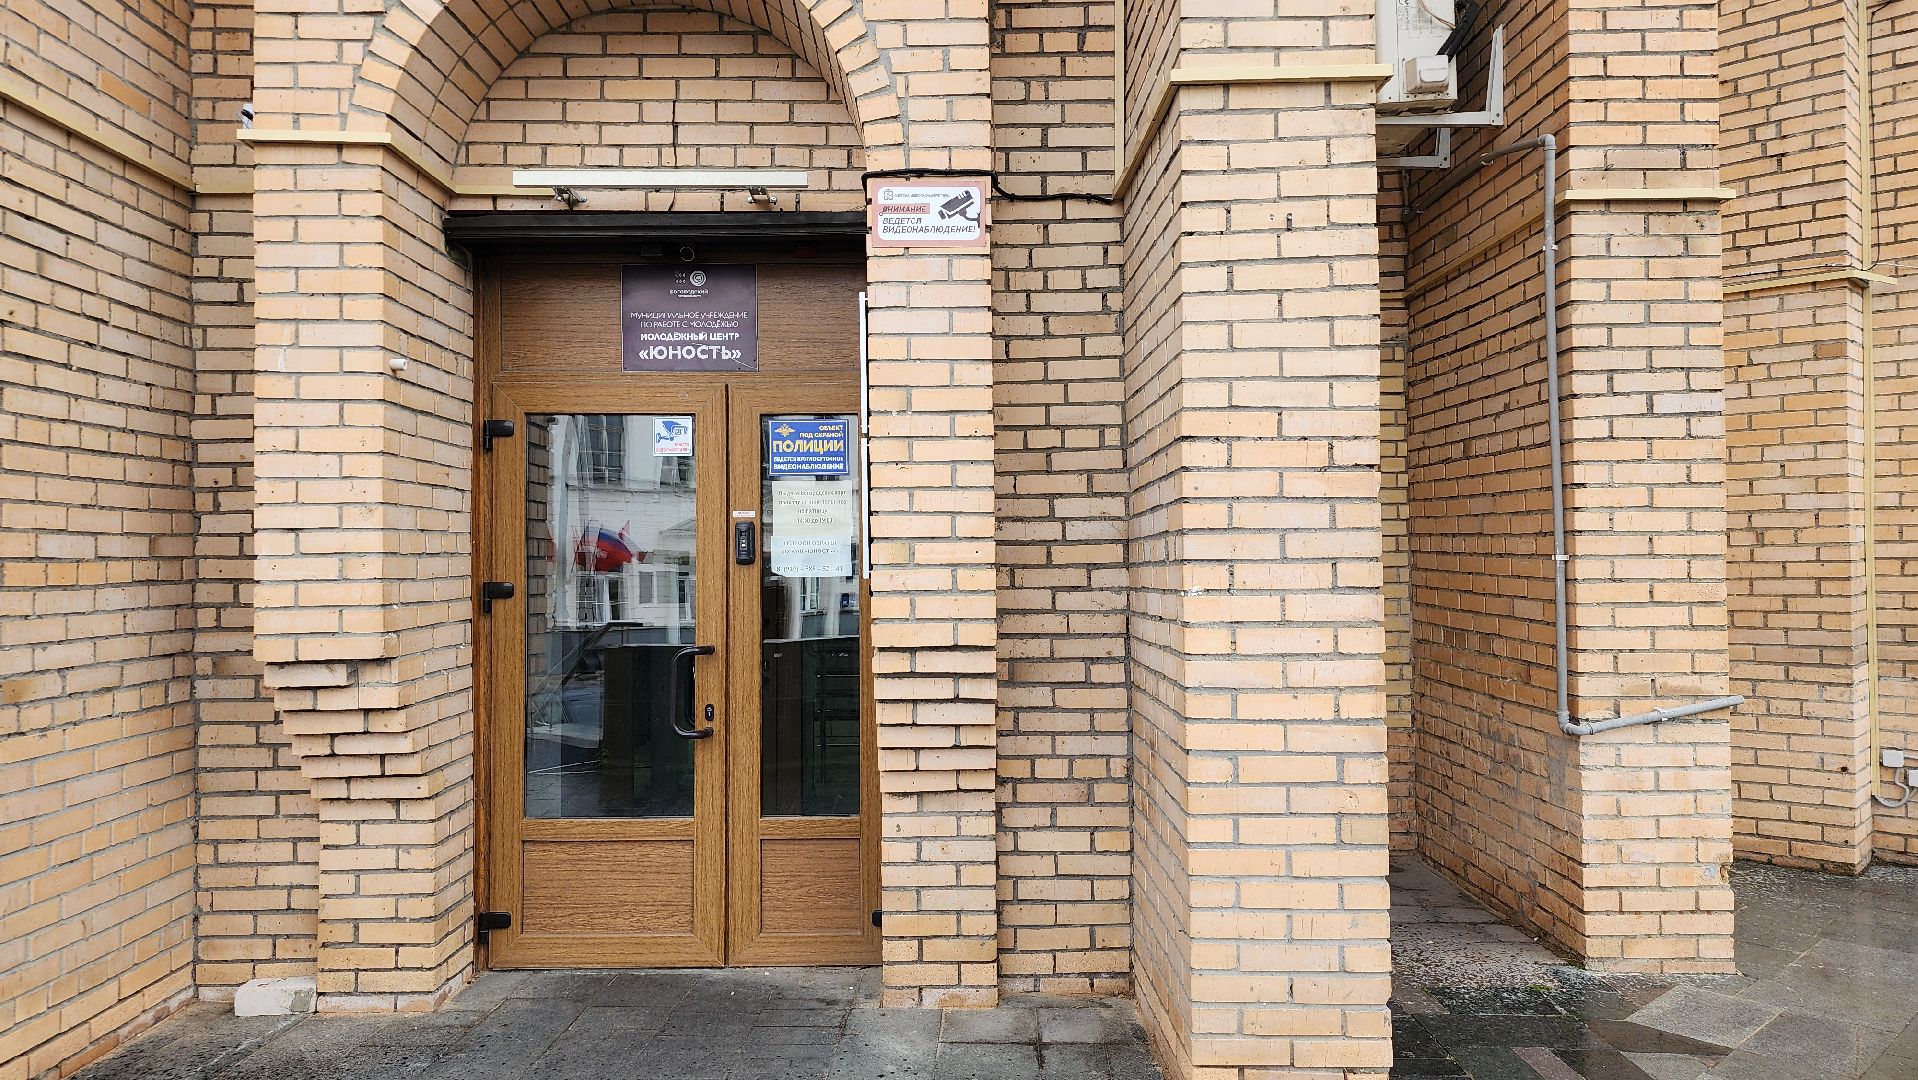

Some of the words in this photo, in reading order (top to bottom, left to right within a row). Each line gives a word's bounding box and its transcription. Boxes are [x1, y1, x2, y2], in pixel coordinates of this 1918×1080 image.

[882, 205, 927, 213] ВНИМАНИЕ
[882, 217, 922, 226] ВЕДЕТСЯ
[882, 225, 976, 235] ВИДЕОНАБЛЮДЕНИЕ!
[630, 311, 700, 320] МУНИЦИПАЛЬНОЕ
[700, 311, 749, 320] УЧРЕЖДЕНИЕ
[653, 320, 681, 328] РАБОТЕ
[681, 320, 688, 328] С
[689, 319, 739, 329] МОЛОДЁЖЬЮ
[640, 331, 708, 342] МОЛОДЁЖНЫЙ
[709, 332, 740, 341] ЦЕНТР
[638, 345, 742, 360] «ЮНОСТЬ»
[814, 430, 844, 438] ОХРАНОЙ
[772, 439, 844, 455] ПОЛИЦИИ
